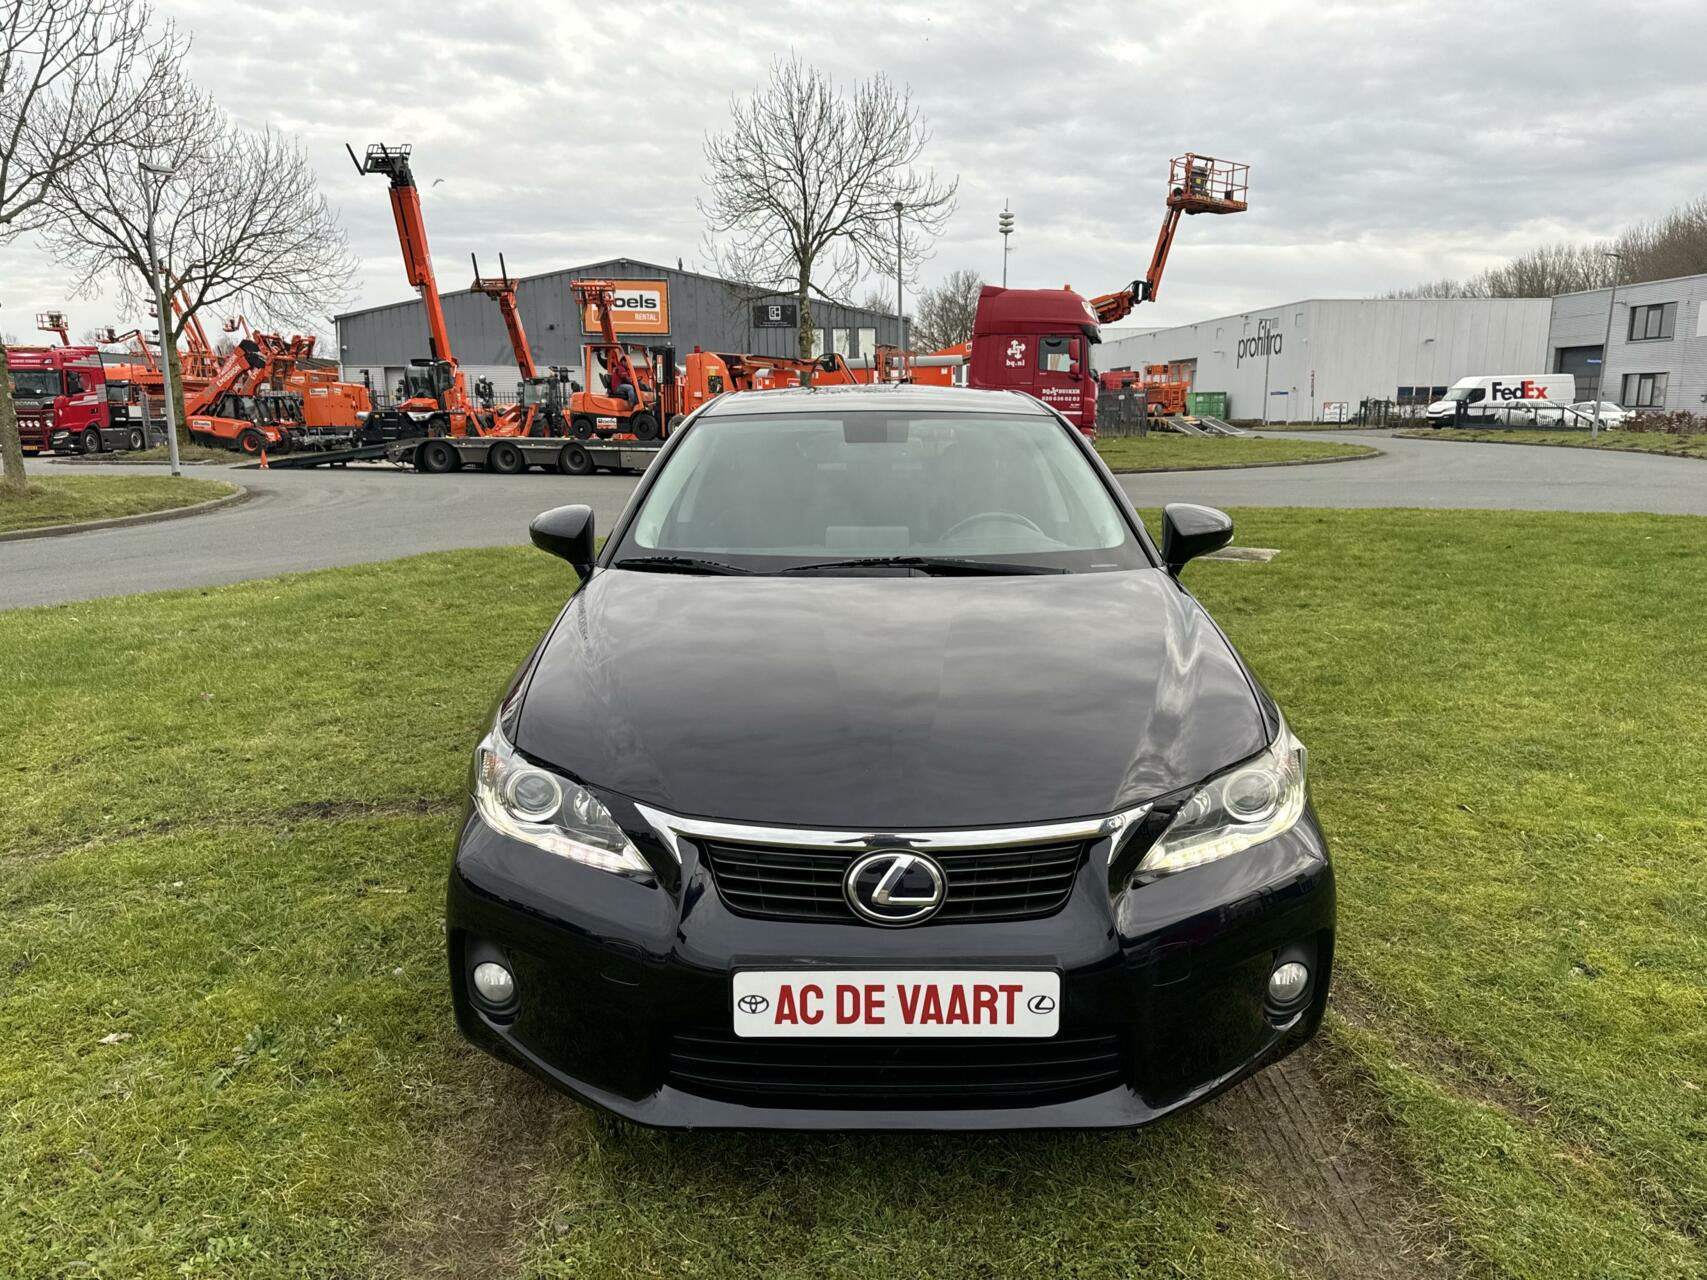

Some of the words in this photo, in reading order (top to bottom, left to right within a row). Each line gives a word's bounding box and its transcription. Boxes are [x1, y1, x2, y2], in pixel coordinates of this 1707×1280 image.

[608, 293, 657, 309] oels
[634, 313, 657, 321] RENTAL
[1236, 319, 1283, 369] profiltra
[1006, 359, 1025, 368] bq.nl
[1491, 380, 1548, 401] FedEx
[774, 984, 824, 1025] AC
[836, 984, 885, 1025] DE
[896, 984, 1023, 1025] VAART
